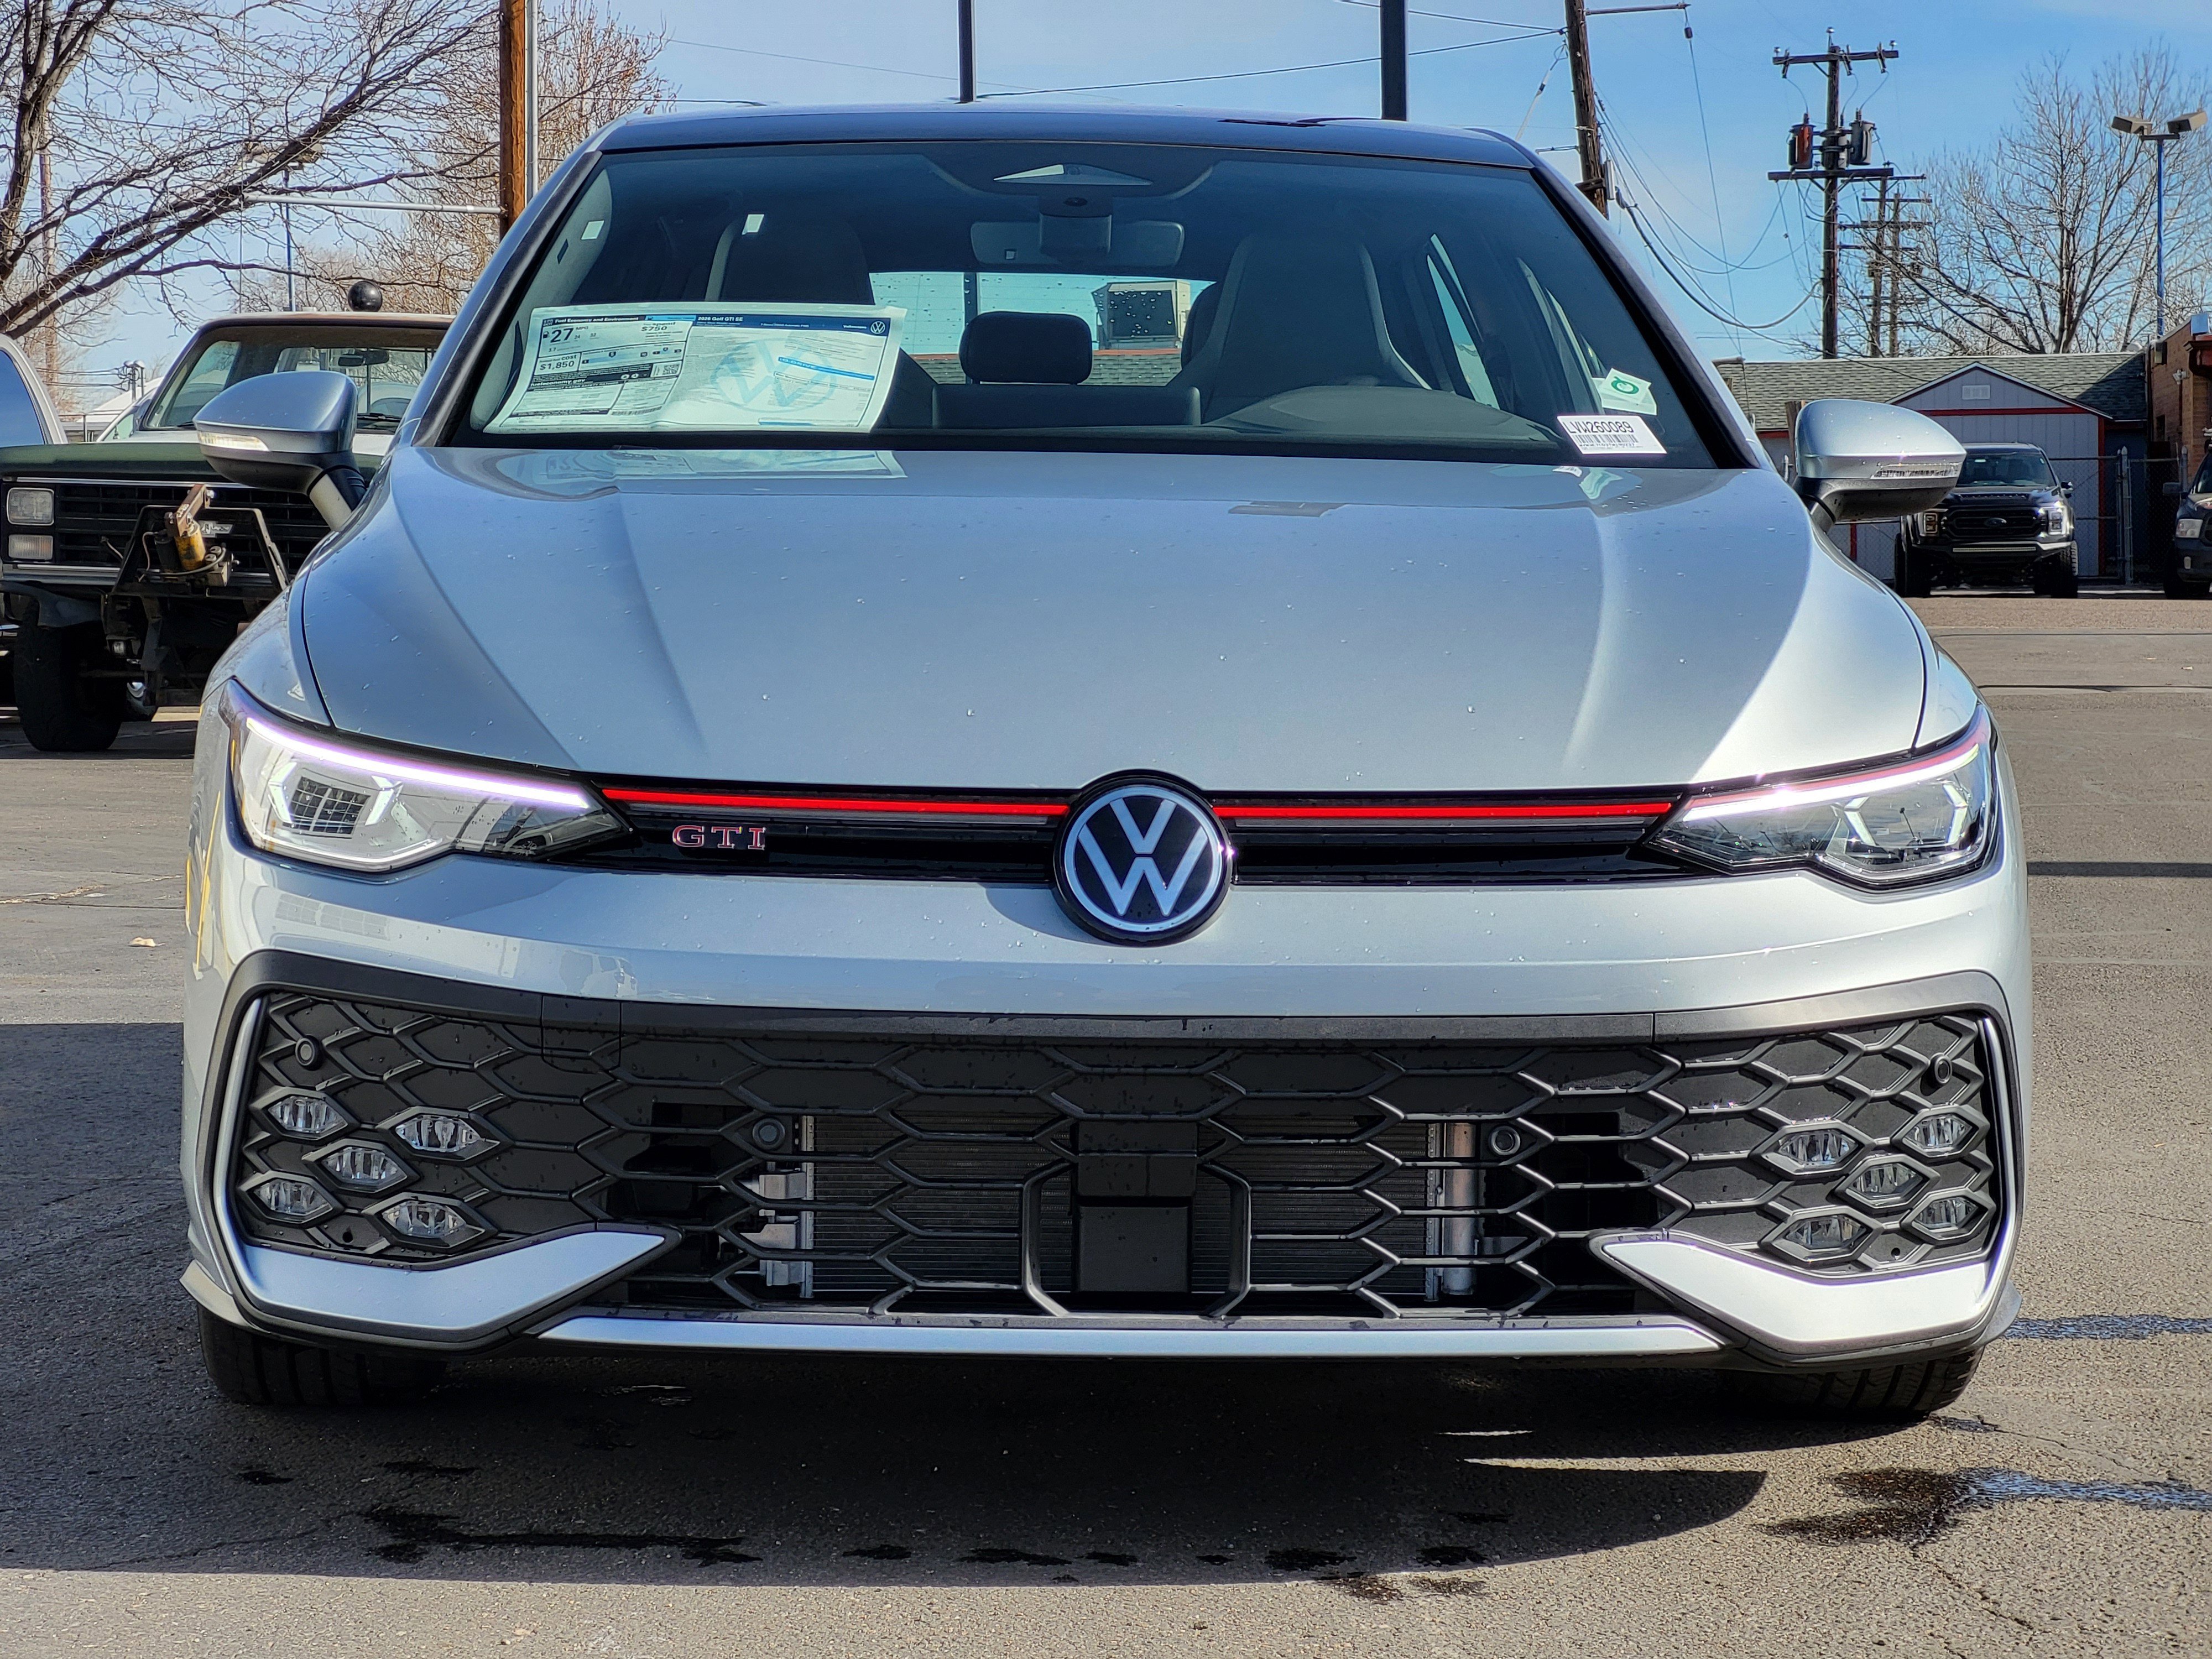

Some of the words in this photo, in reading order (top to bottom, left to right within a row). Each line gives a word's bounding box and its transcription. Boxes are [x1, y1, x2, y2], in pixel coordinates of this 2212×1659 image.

[550, 328, 574, 343] 27
[540, 361, 575, 370] $1,850
[1563, 421, 1634, 434] LVW260089
[672, 825, 766, 851] GTI
